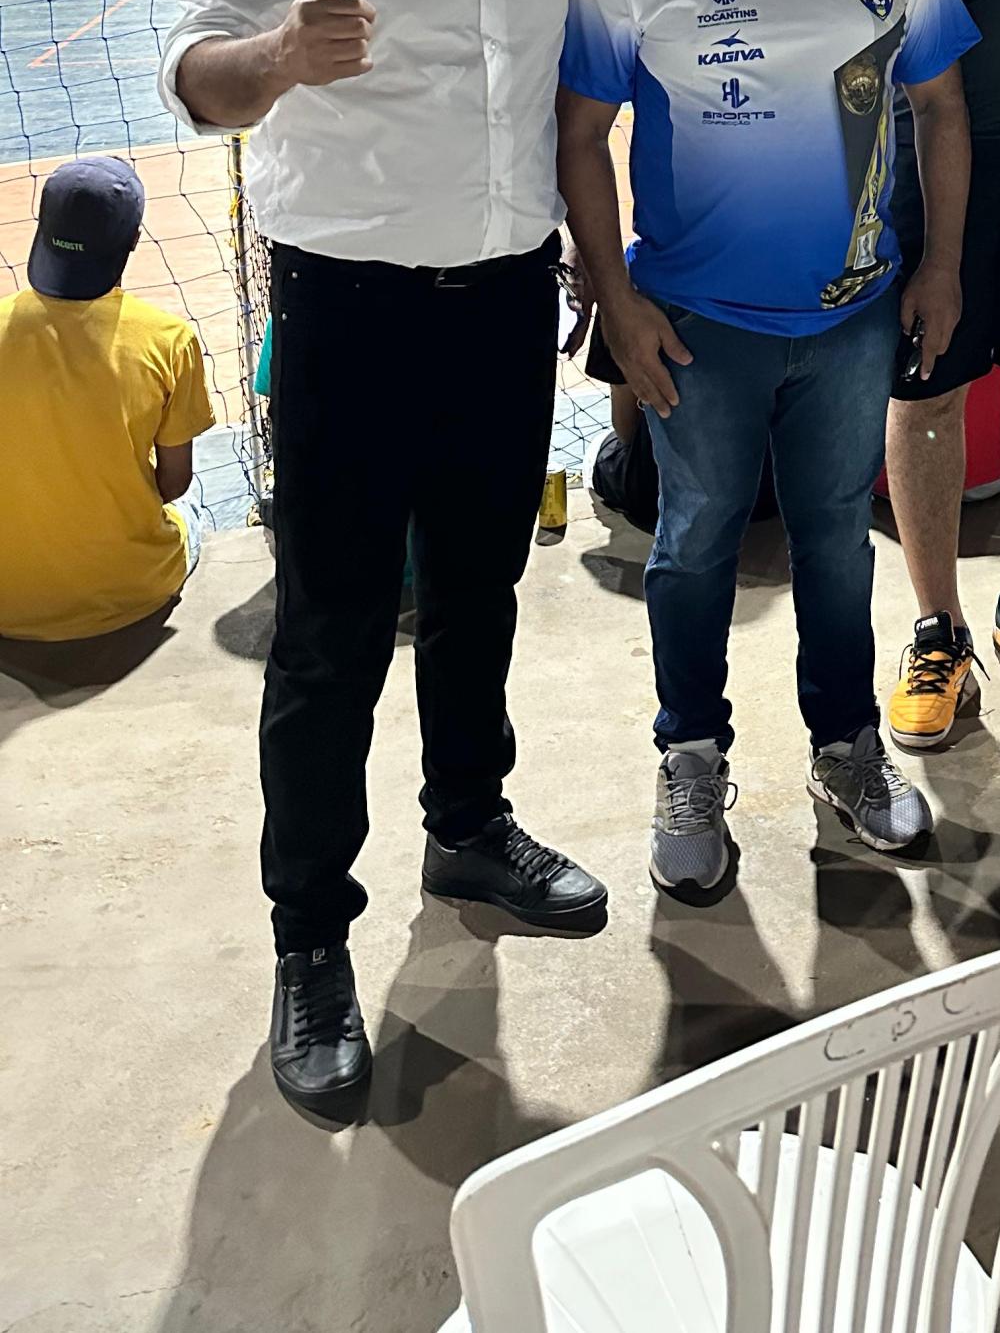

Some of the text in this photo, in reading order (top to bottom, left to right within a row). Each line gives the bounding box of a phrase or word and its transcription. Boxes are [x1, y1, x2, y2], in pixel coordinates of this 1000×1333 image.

[696, 9, 758, 24] TOCANTINS
[698, 48, 765, 65] KAGIVA
[702, 111, 776, 120] SPORTS
[52, 237, 84, 251] LACOSTE
